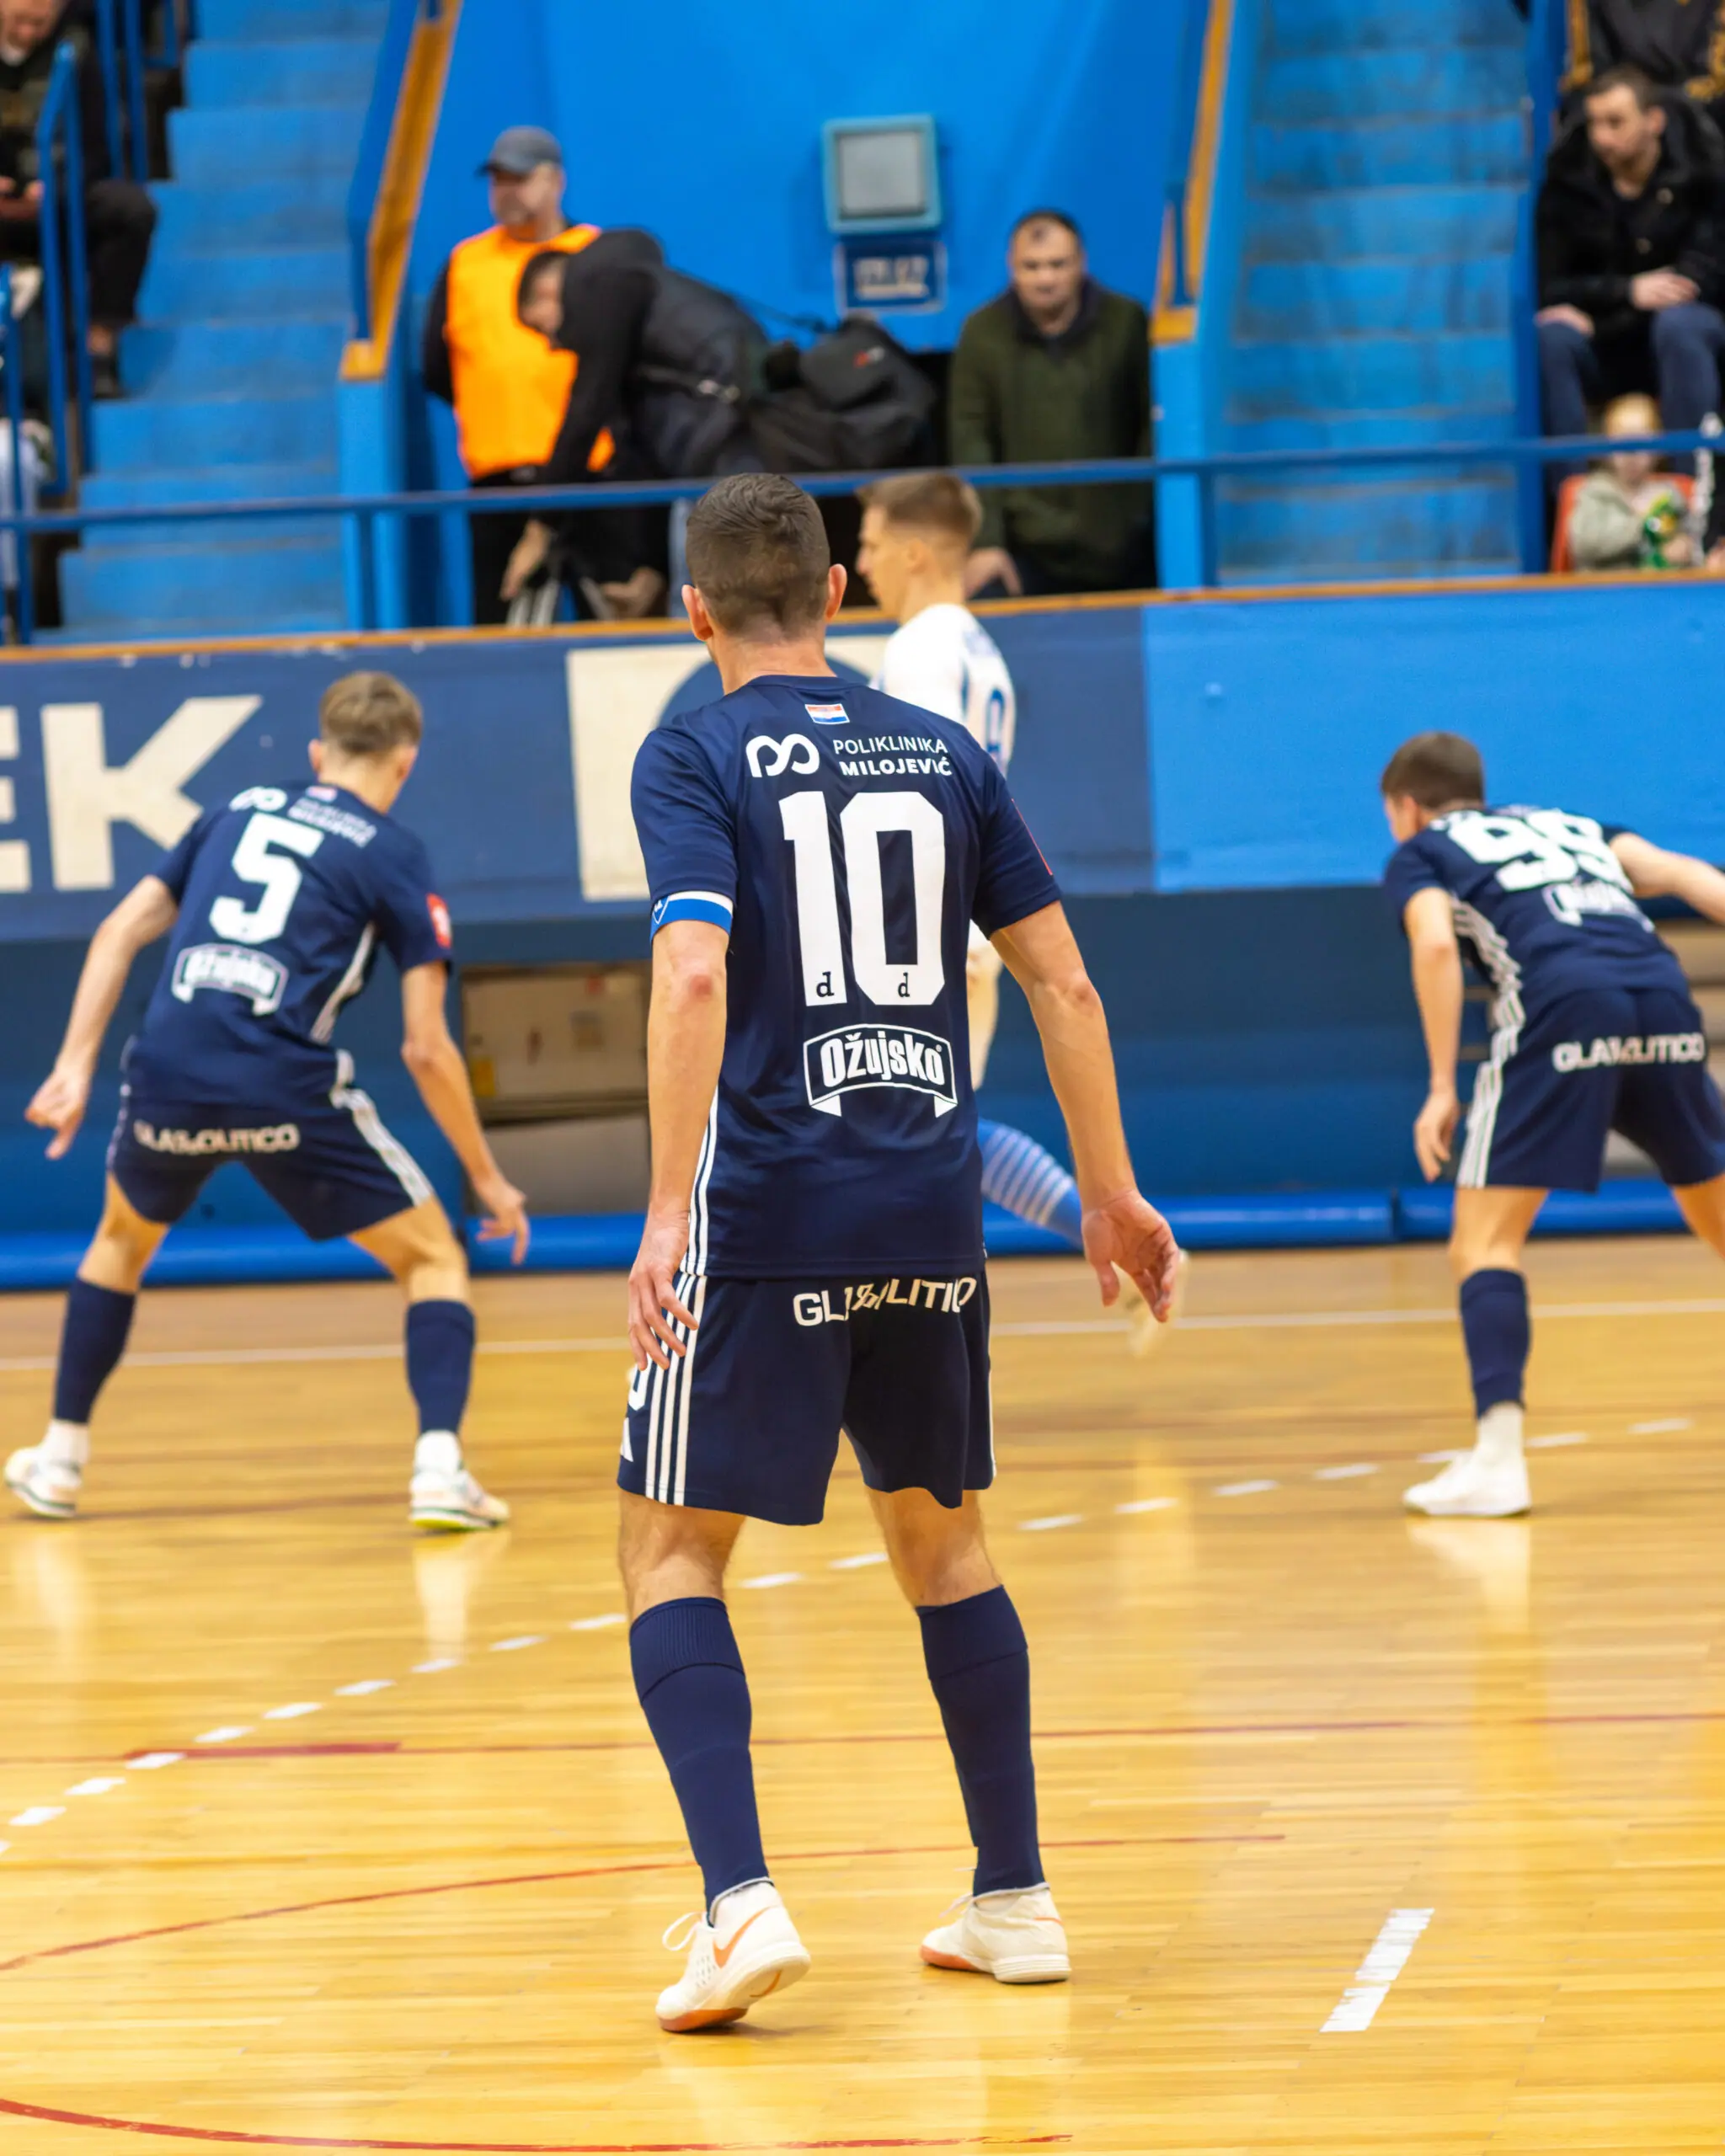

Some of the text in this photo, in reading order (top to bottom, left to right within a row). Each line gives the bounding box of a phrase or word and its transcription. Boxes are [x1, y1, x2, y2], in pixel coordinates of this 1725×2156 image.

[832, 735, 948, 755] POLIKLINIKA
[840, 755, 953, 776] MILOJEVIĆ
[209, 812, 325, 945] 5
[778, 791, 946, 1007] 10
[820, 1030, 945, 1087] Ožujsko
